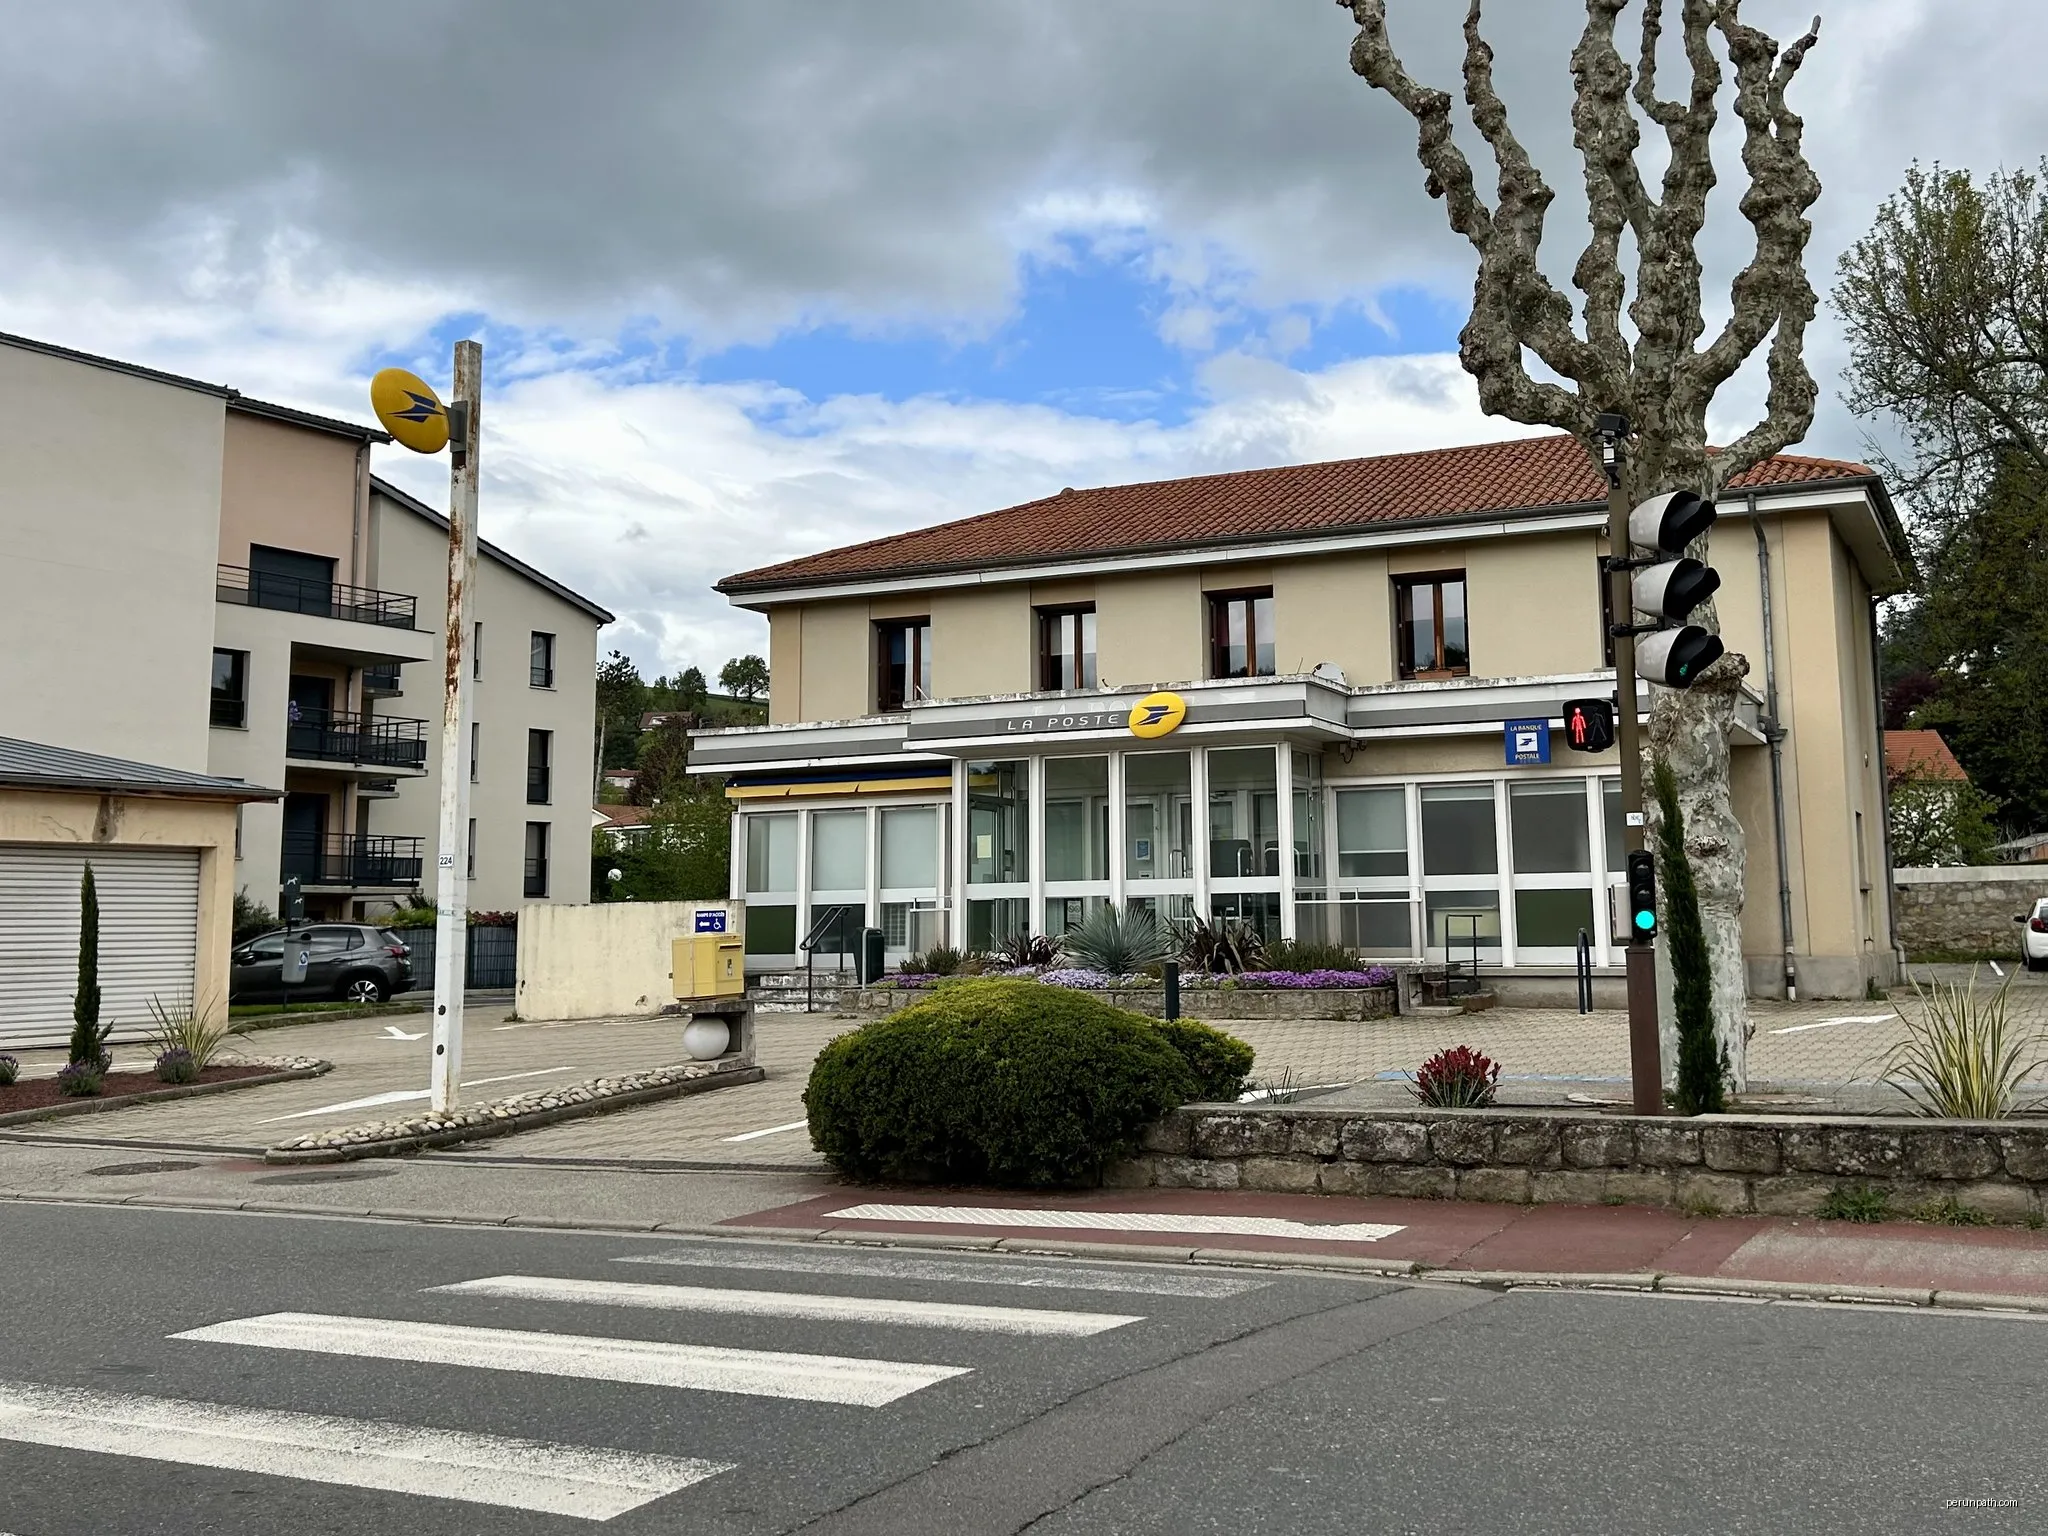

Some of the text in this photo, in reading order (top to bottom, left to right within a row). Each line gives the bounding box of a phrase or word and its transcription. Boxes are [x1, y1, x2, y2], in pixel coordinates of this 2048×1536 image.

[1007, 713, 1120, 731] LA POSTE
[440, 856, 453, 865] 224
